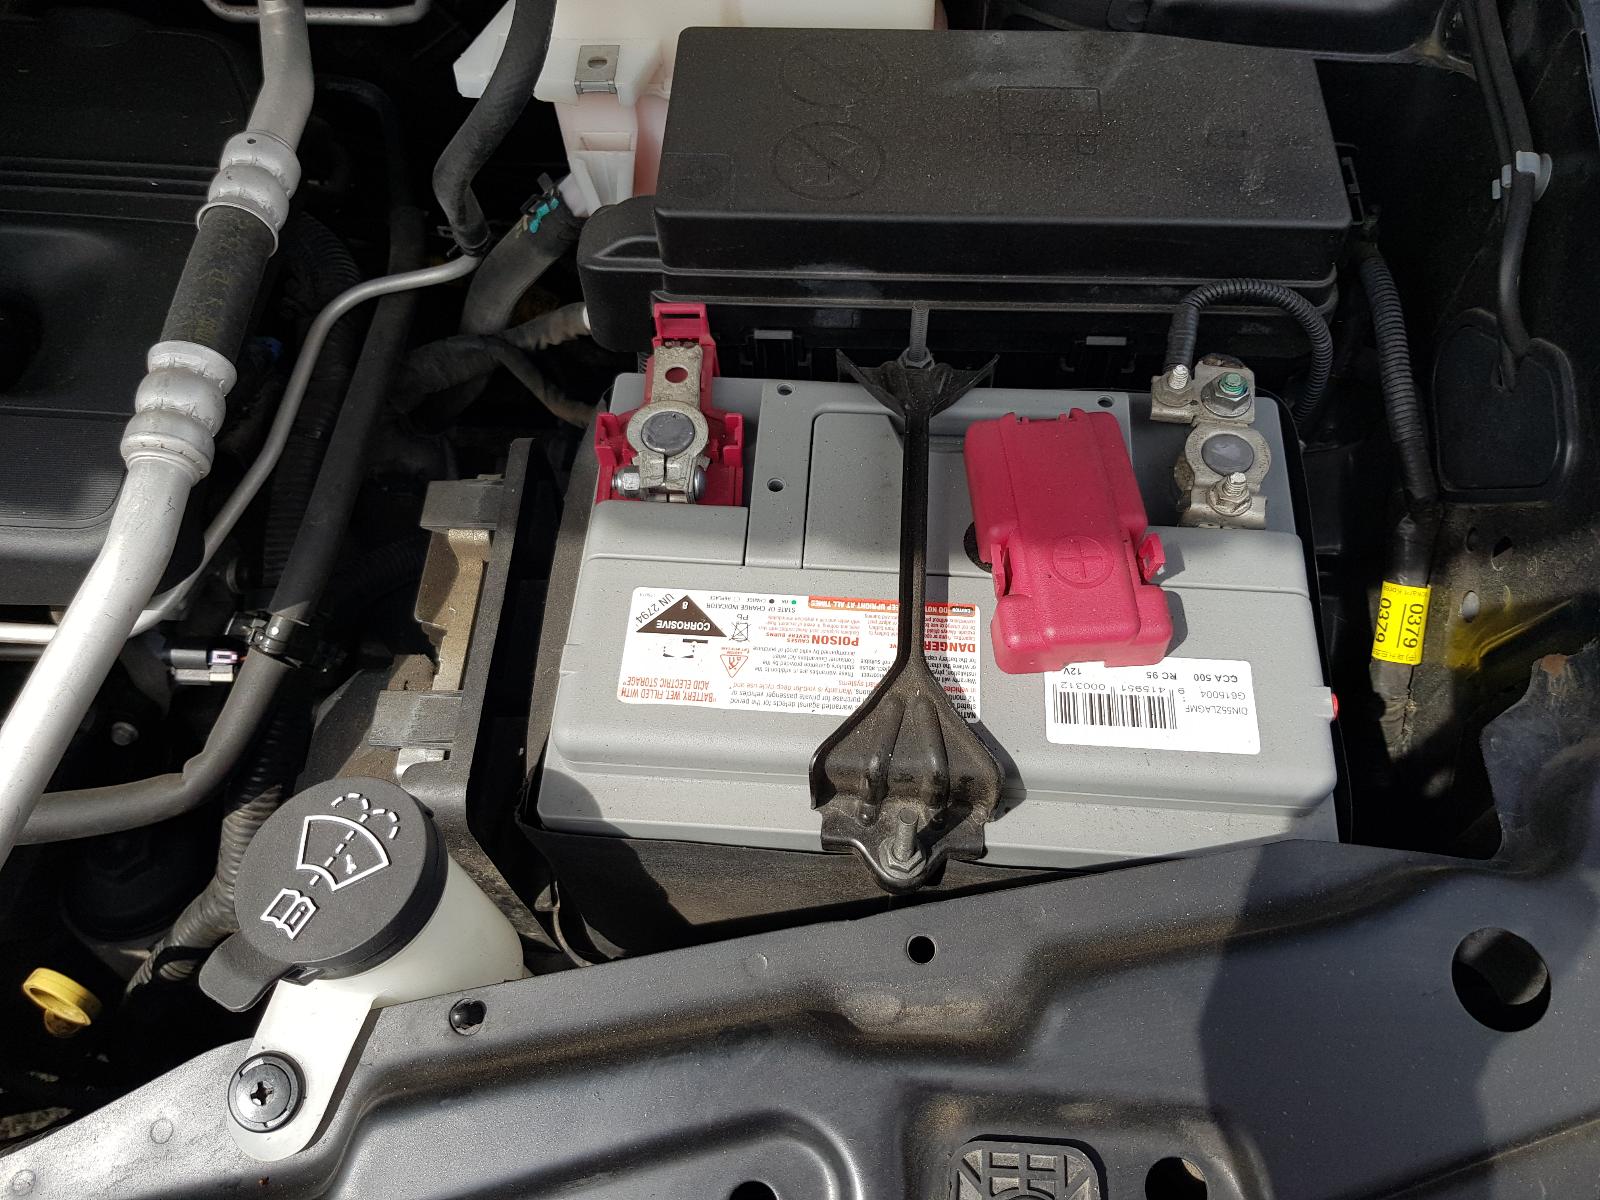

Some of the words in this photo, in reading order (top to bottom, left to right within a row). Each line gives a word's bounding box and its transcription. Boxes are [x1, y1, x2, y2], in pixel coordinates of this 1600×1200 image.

[658, 593, 675, 607] UN
[682, 601, 689, 610] 8
[635, 603, 660, 624] 2794
[938, 606, 948, 614] DO
[736, 613, 749, 621] Pb
[1375, 597, 1391, 643] 0379
[655, 620, 711, 631] CORROSIVE
[1403, 604, 1424, 648] 0379
[811, 635, 859, 647] POISON
[923, 641, 976, 653] DANGER
[1161, 672, 1177, 680] RC
[1193, 673, 1212, 681] 500
[1214, 674, 1238, 683] CCA
[659, 678, 692, 689] ELECTRIC
[693, 680, 710, 691] ACID
[1060, 682, 1106, 691] 000312
[1121, 685, 1165, 693] 415951
[621, 687, 639, 698] WITH
[640, 689, 664, 700] FILLED
[765, 690, 797, 699] passenger
